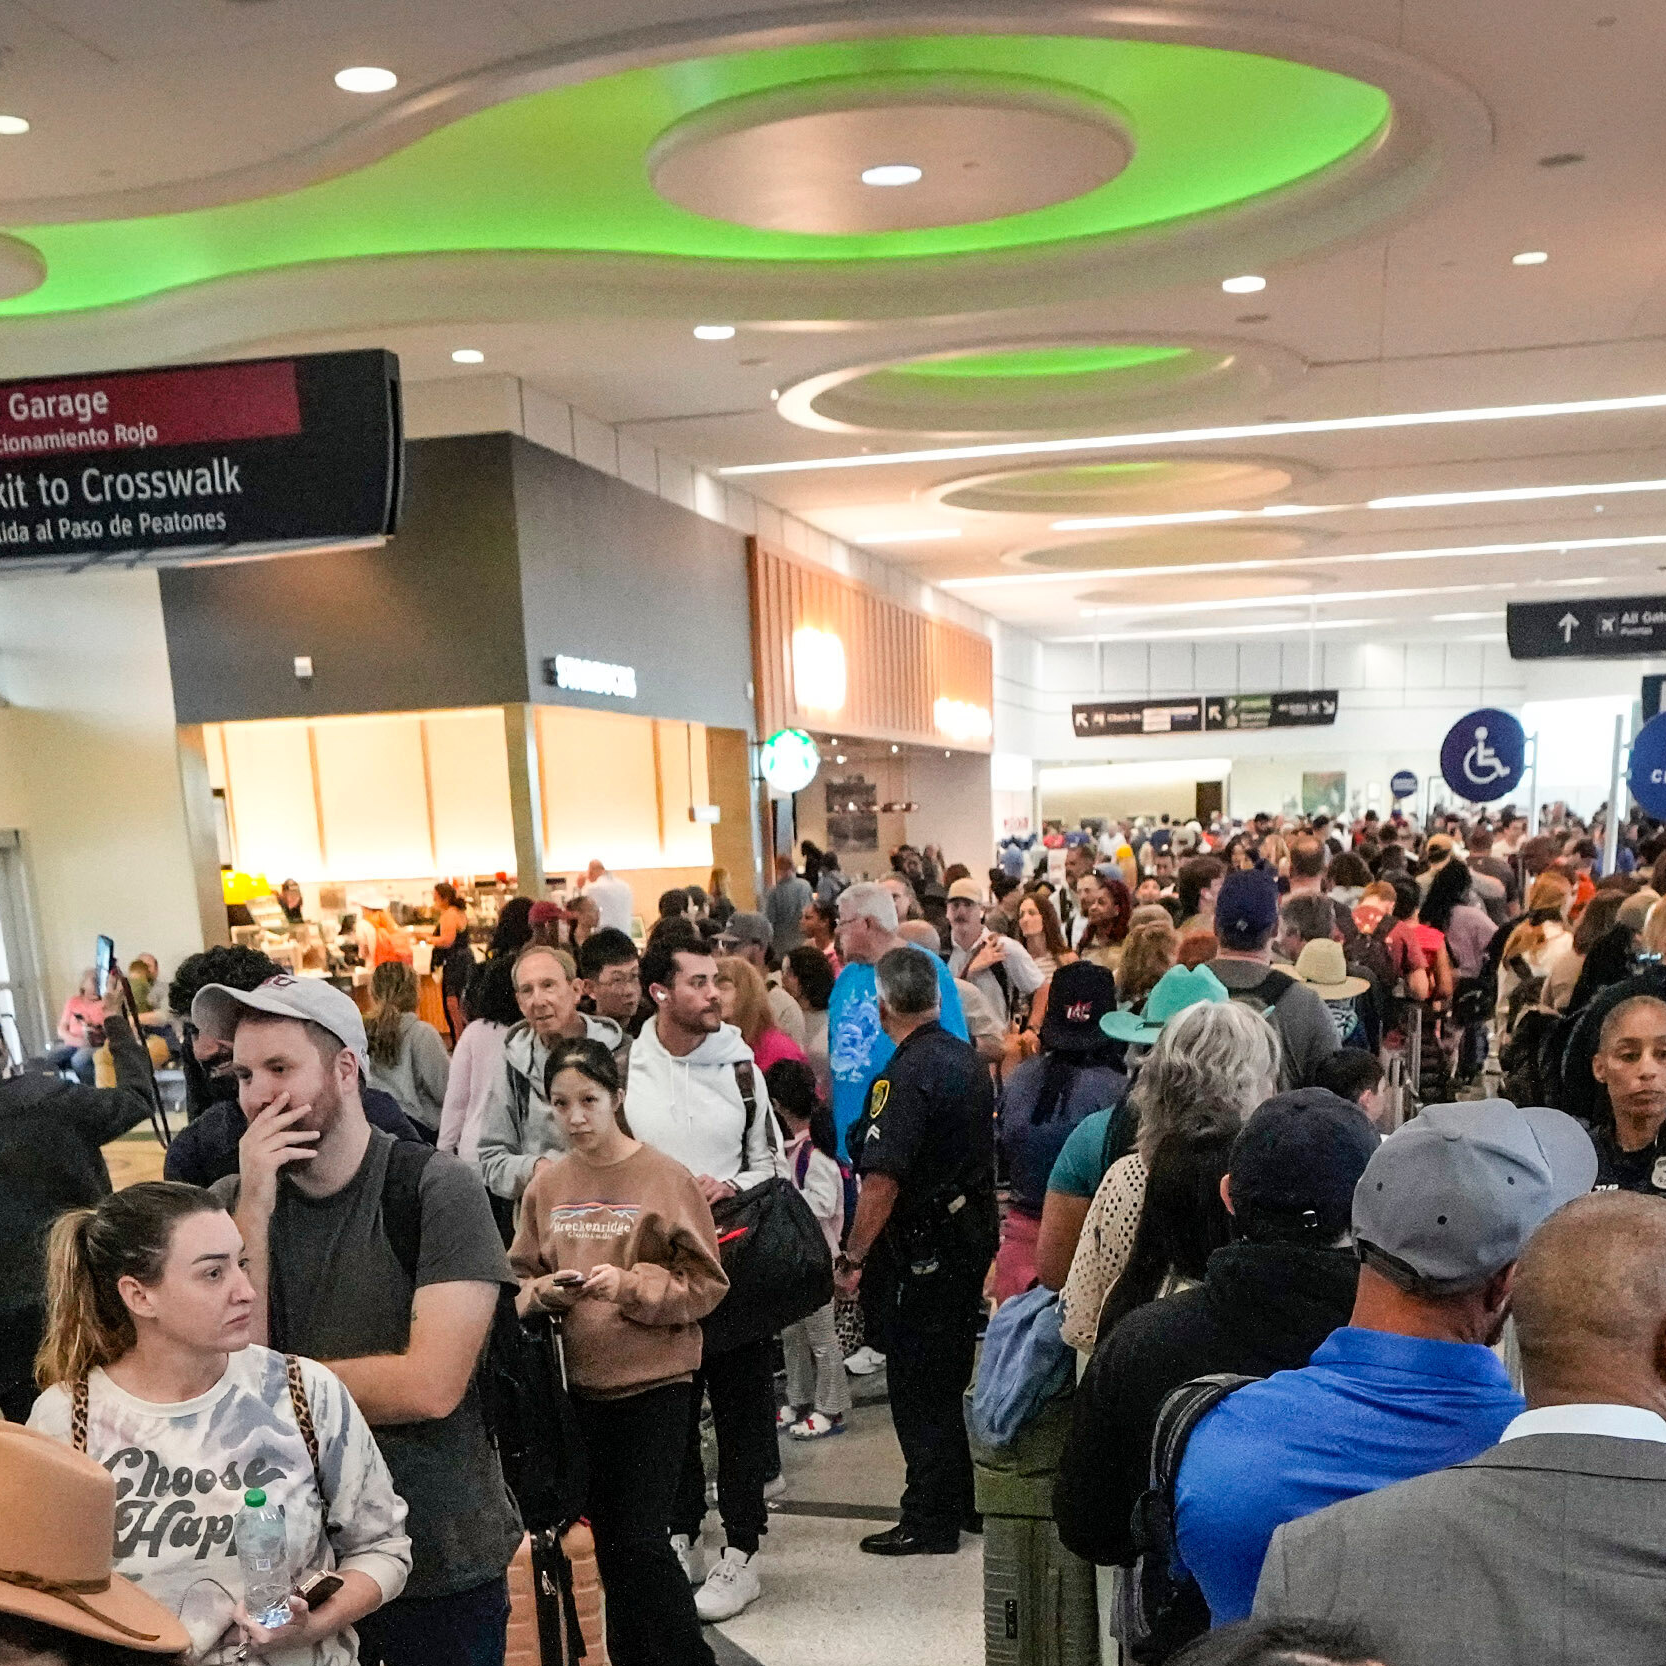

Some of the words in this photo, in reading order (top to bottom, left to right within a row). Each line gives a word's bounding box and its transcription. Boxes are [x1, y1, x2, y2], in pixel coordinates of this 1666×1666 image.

[9, 390, 110, 422] Garage
[114, 422, 158, 448] Rojo
[39, 473, 70, 507] to
[81, 457, 243, 503] Crosswalk
[35, 518, 53, 542] al
[58, 516, 104, 540] Paso
[109, 513, 132, 537] de
[138, 509, 228, 534] Peatones
[101, 1446, 288, 1501] Choose
